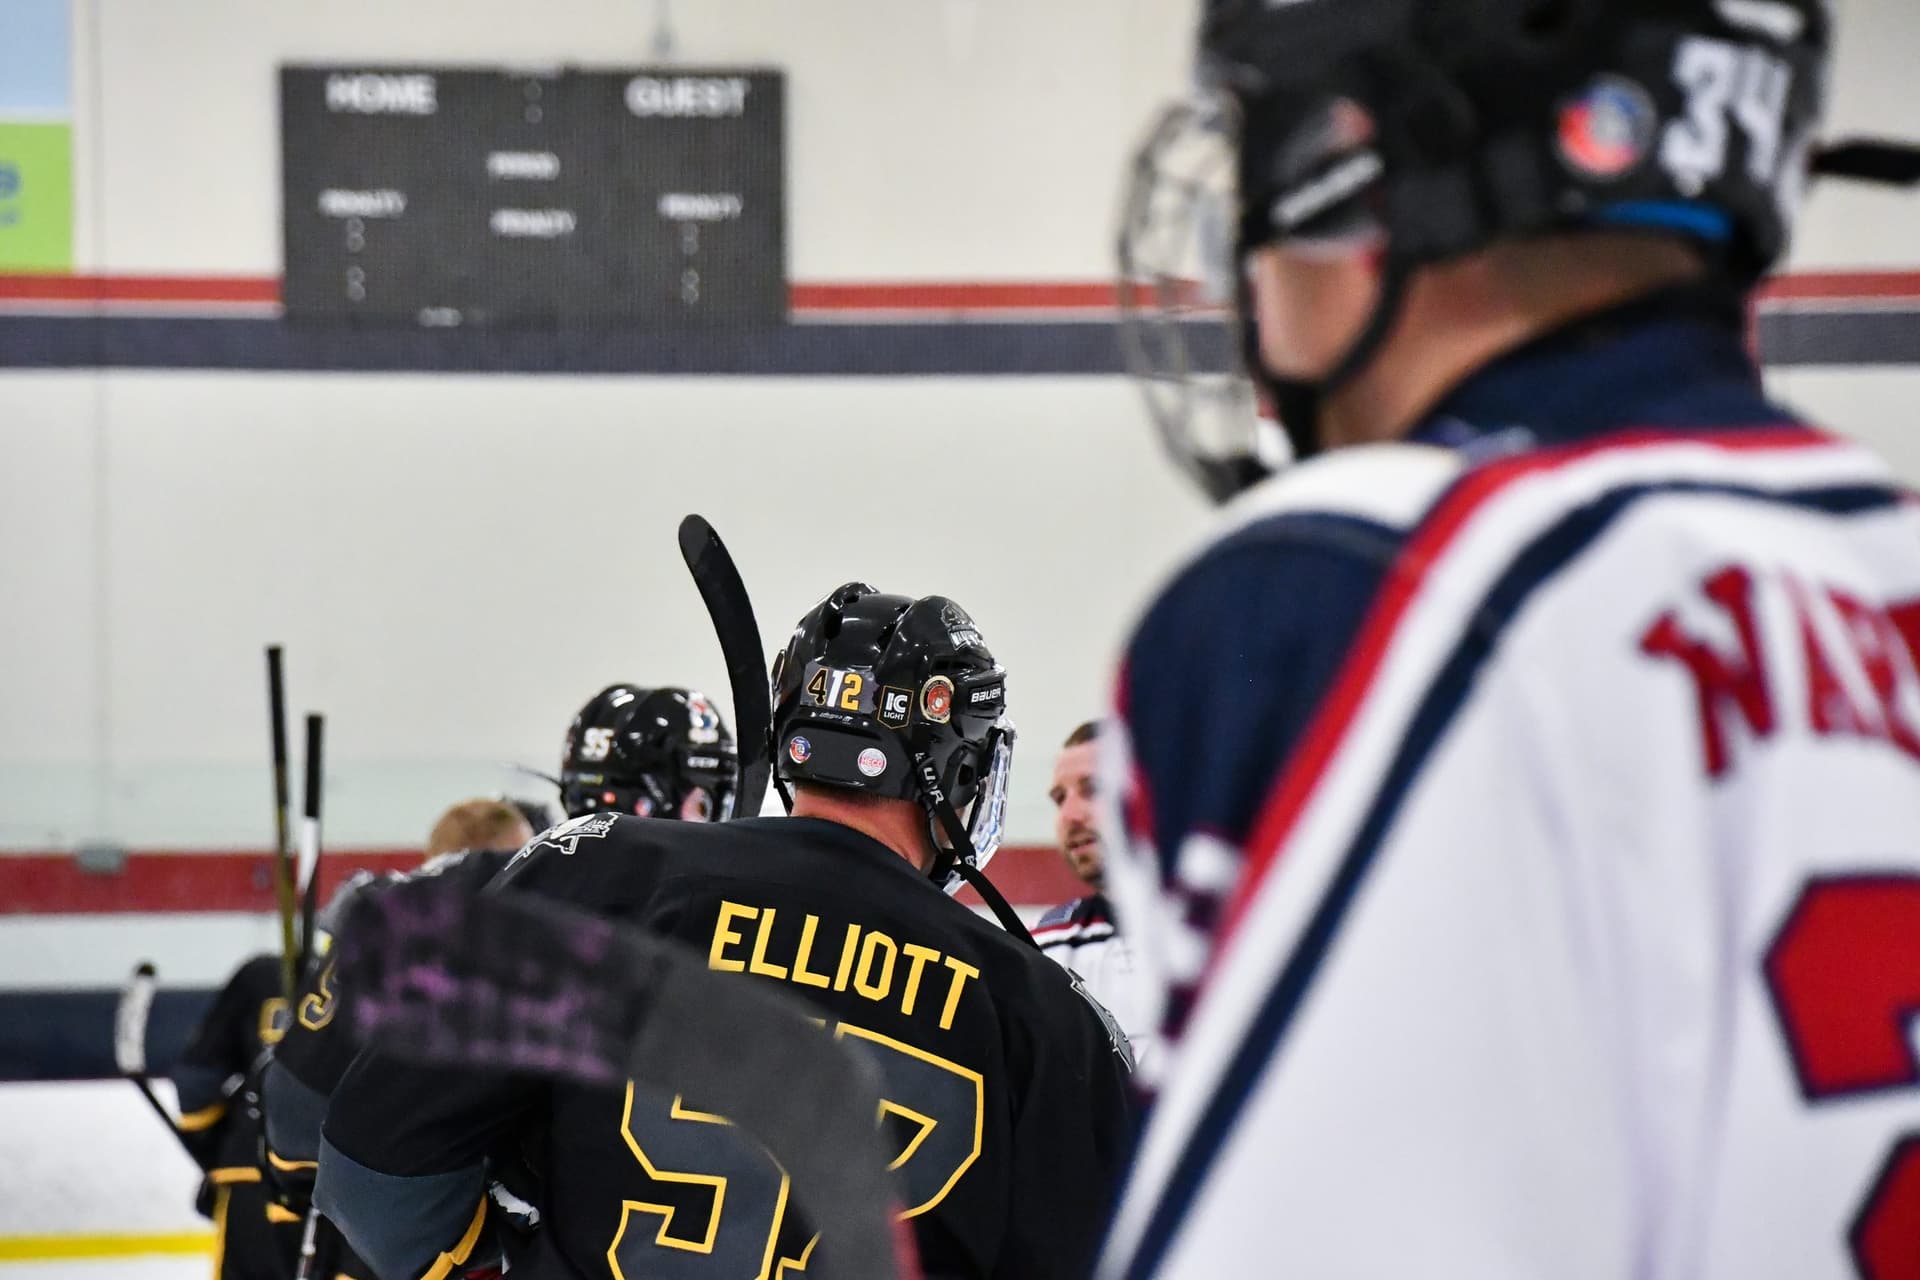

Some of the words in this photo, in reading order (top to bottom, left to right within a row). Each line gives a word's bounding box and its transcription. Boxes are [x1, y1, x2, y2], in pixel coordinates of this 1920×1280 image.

[325, 74, 437, 114] HOME
[624, 76, 750, 117] GUEST
[1661, 37, 1791, 190] 34
[806, 667, 864, 711] 412
[885, 692, 908, 713] IC
[970, 688, 1001, 703] BAUER
[884, 711, 905, 720] LIGHT
[708, 900, 980, 1030] ELLIOTT
